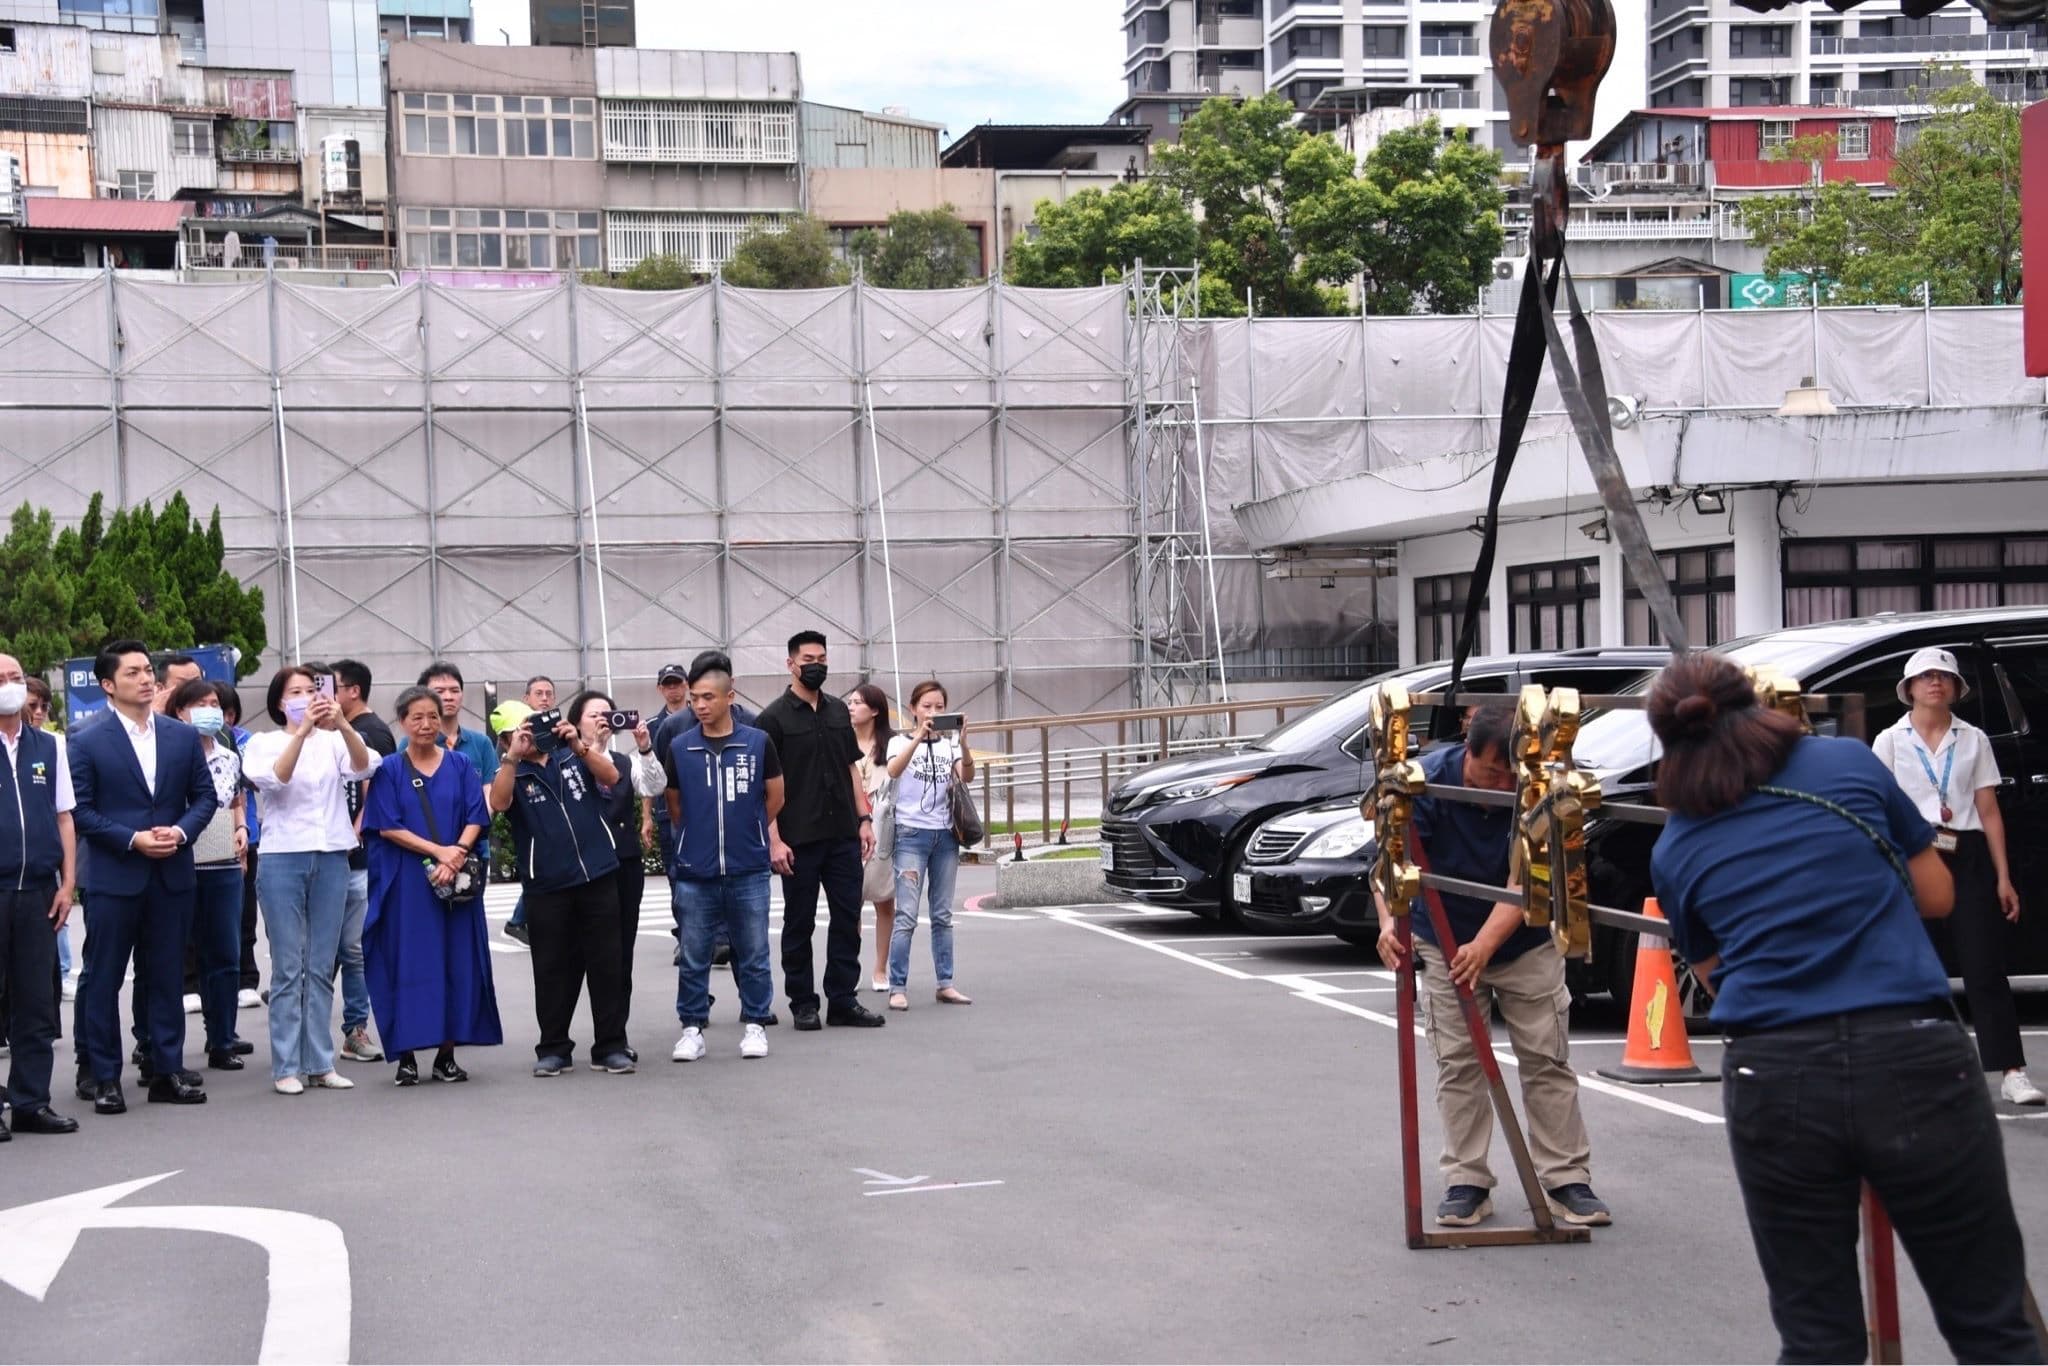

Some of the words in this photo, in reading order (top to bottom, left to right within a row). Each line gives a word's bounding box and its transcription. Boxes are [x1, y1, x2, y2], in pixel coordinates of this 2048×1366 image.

[73, 672, 85, 686] P
[931, 755, 953, 767] ORK
[736, 754, 749, 794] 王鴻薇
